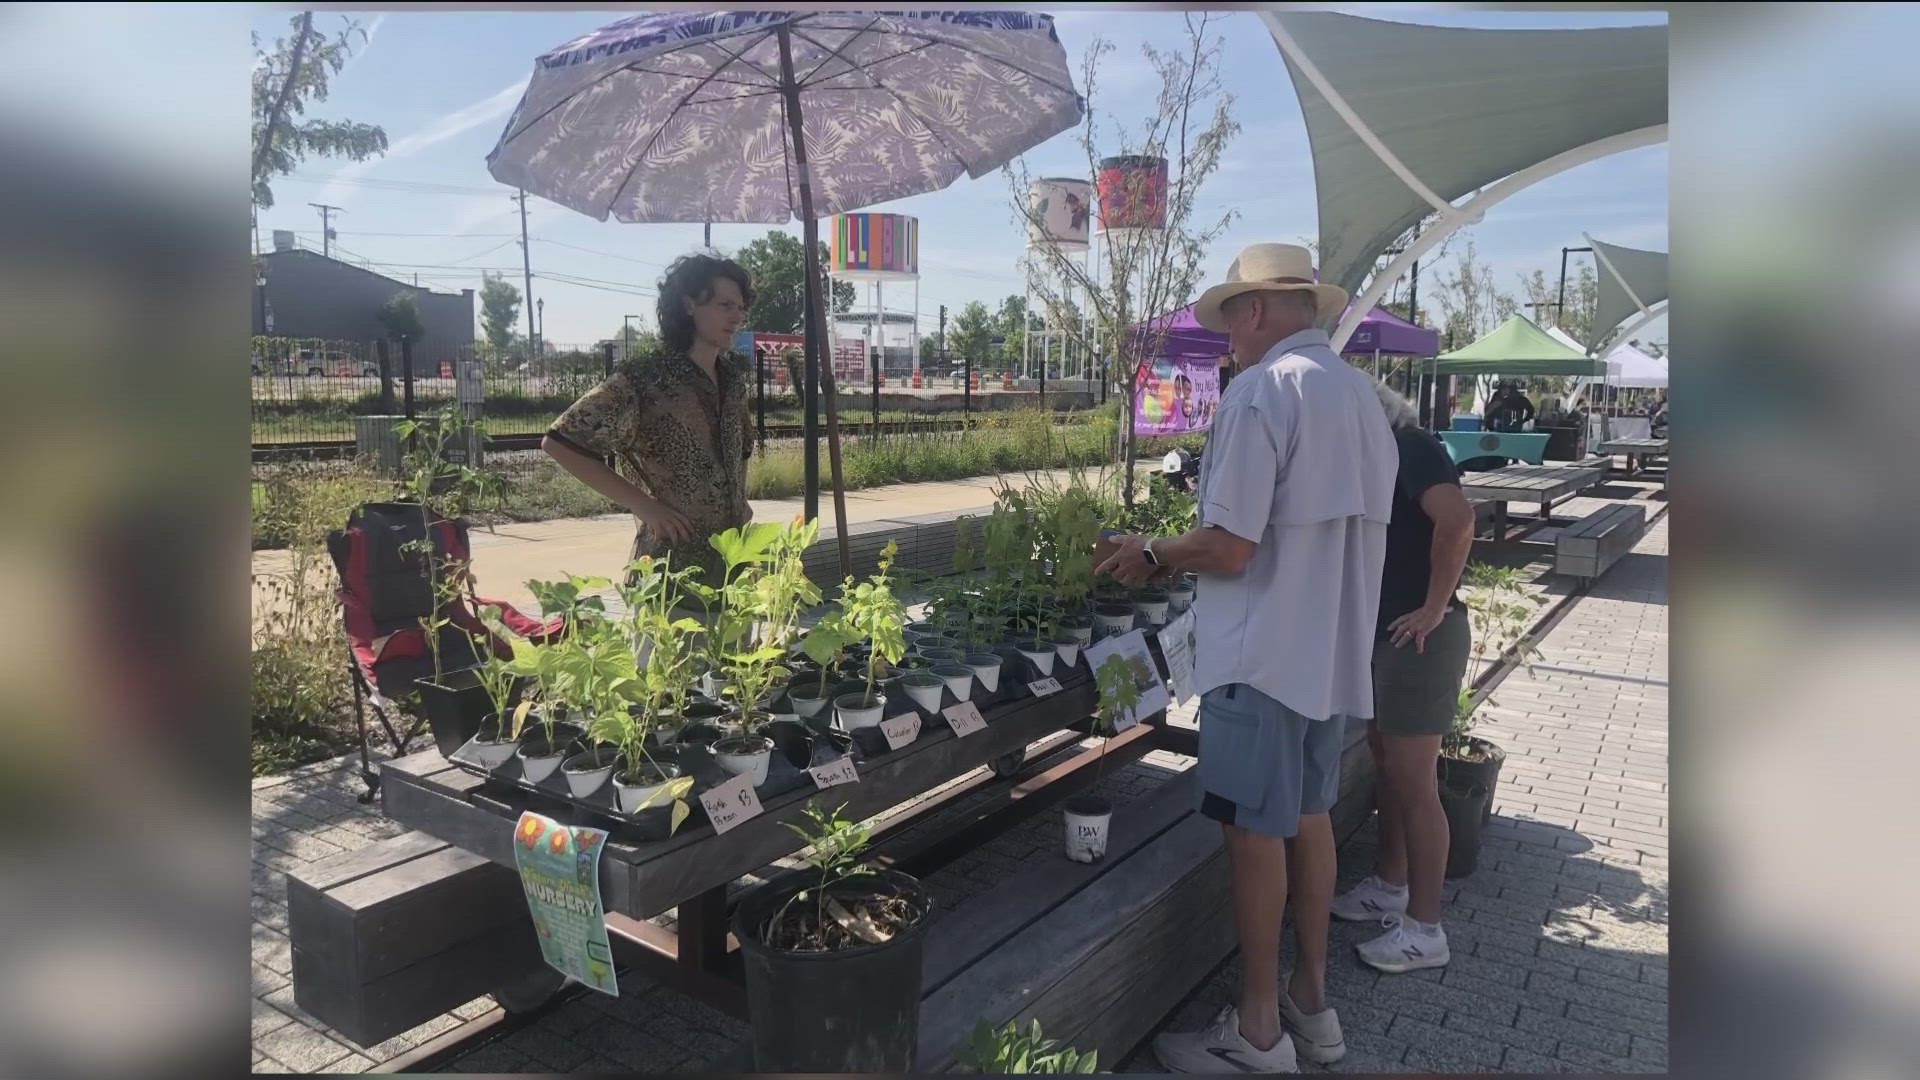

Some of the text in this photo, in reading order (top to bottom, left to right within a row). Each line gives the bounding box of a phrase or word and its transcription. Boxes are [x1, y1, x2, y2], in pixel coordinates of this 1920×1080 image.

[951, 718, 968, 730] Dill
[738, 789, 751, 807] $3
[713, 812, 737, 826] Bean
[525, 880, 597, 918] NURSERY
[1360, 899, 1384, 912] N
[1401, 944, 1425, 961] N
